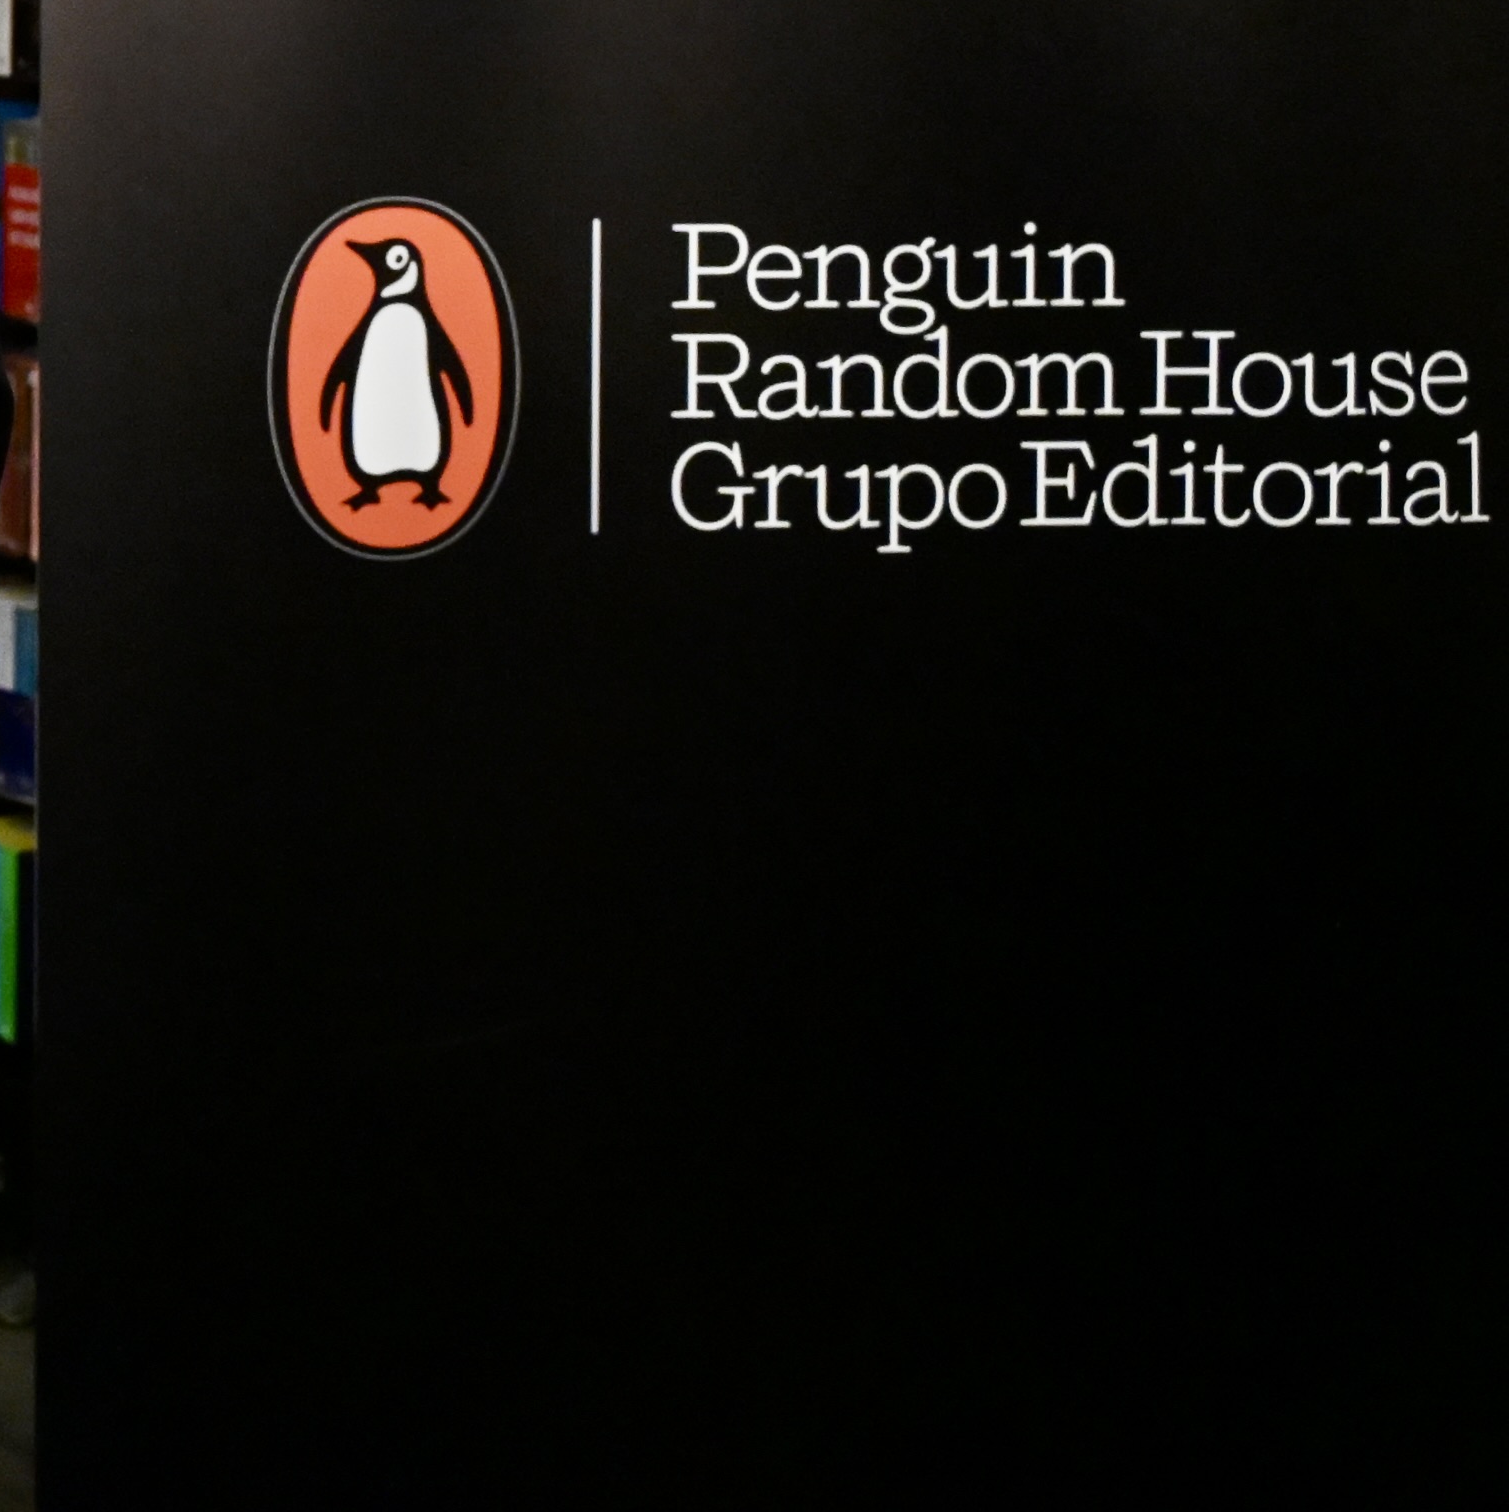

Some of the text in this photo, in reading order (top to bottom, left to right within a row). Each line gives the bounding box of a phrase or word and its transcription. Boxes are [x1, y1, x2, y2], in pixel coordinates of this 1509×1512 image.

[670, 221, 1126, 336] Penguin
[669, 326, 1469, 420] Random House
[670, 431, 1492, 555] Grupo Editorial
